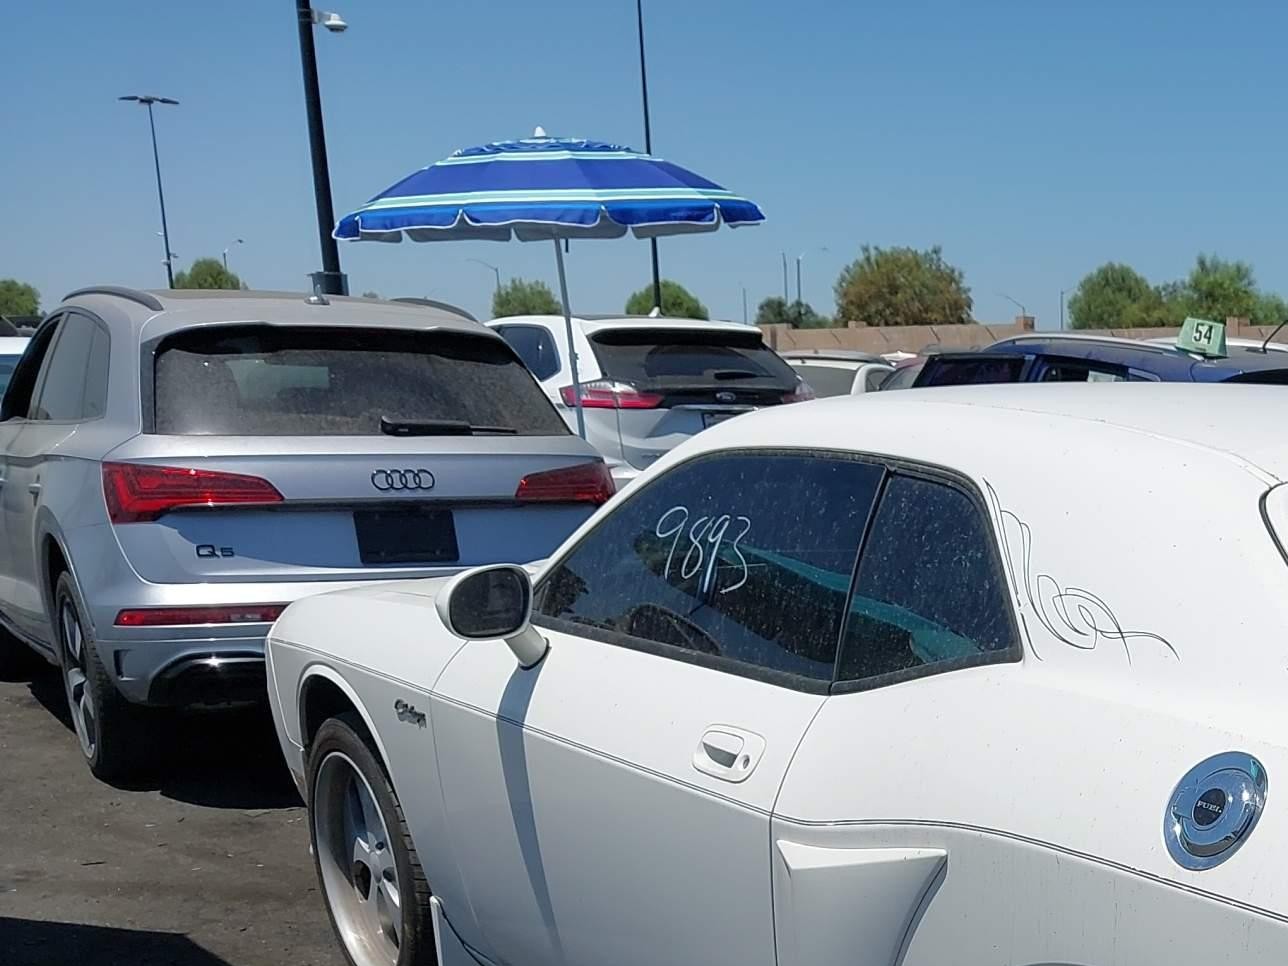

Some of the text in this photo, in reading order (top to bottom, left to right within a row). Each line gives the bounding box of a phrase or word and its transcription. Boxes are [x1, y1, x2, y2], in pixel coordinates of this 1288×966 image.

[1193, 322, 1213, 345] 54
[196, 544, 234, 559] Q5
[656, 505, 751, 594] 9893
[1197, 800, 1222, 813] FUEL
